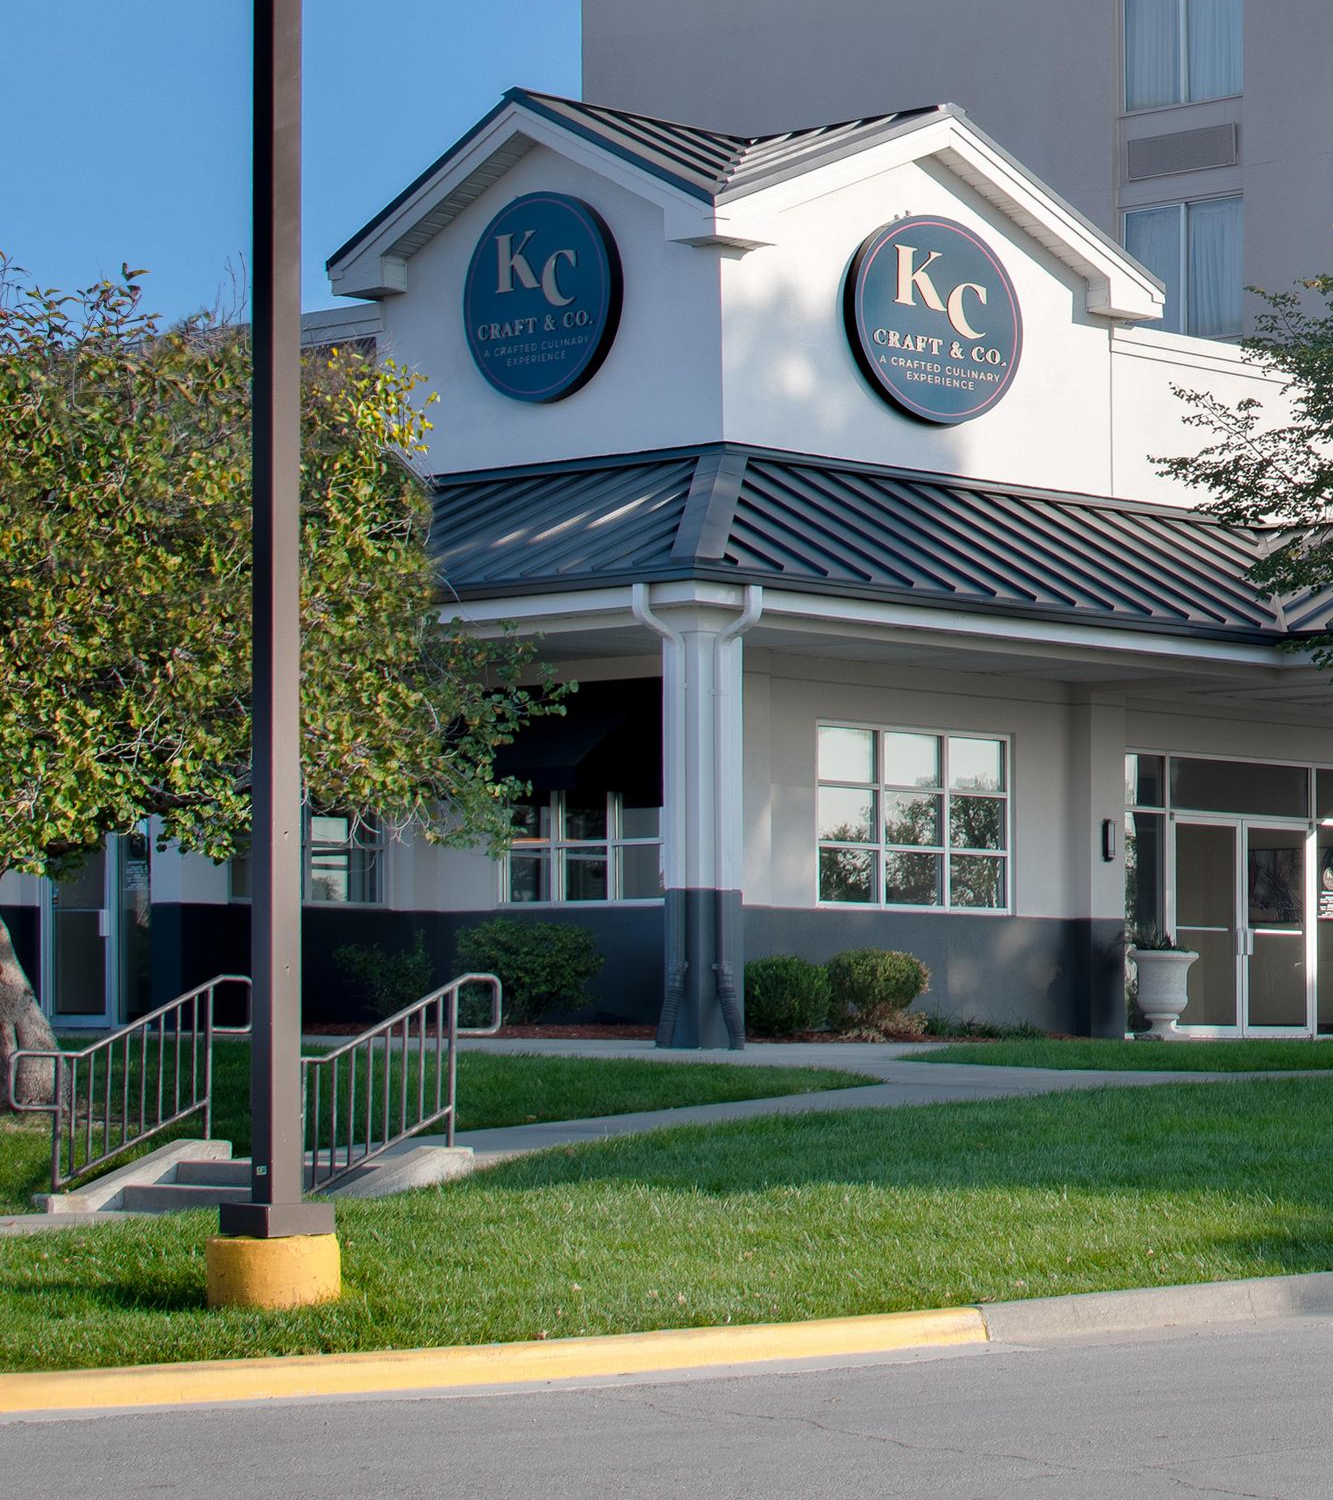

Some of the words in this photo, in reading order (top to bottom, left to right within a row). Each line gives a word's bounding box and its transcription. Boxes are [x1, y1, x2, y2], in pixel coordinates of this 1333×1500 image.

[494, 229, 578, 308] KC
[892, 243, 988, 340] KC
[477, 316, 539, 342] CRAFT
[543, 314, 557, 332] &
[563, 308, 595, 328] CO.
[483, 349, 492, 359] A
[494, 342, 538, 358] CRAFTED
[541, 335, 590, 350] CULINARY
[506, 350, 567, 367] EXPERIENCE
[872, 328, 943, 356] CRAFT
[949, 341, 966, 361] &
[970, 345, 1008, 368] CO.
[879, 355, 888, 365] A
[891, 356, 942, 374] CRAFTED
[945, 365, 1001, 384] CULINARY
[906, 371, 976, 391] EXPERIENCE
